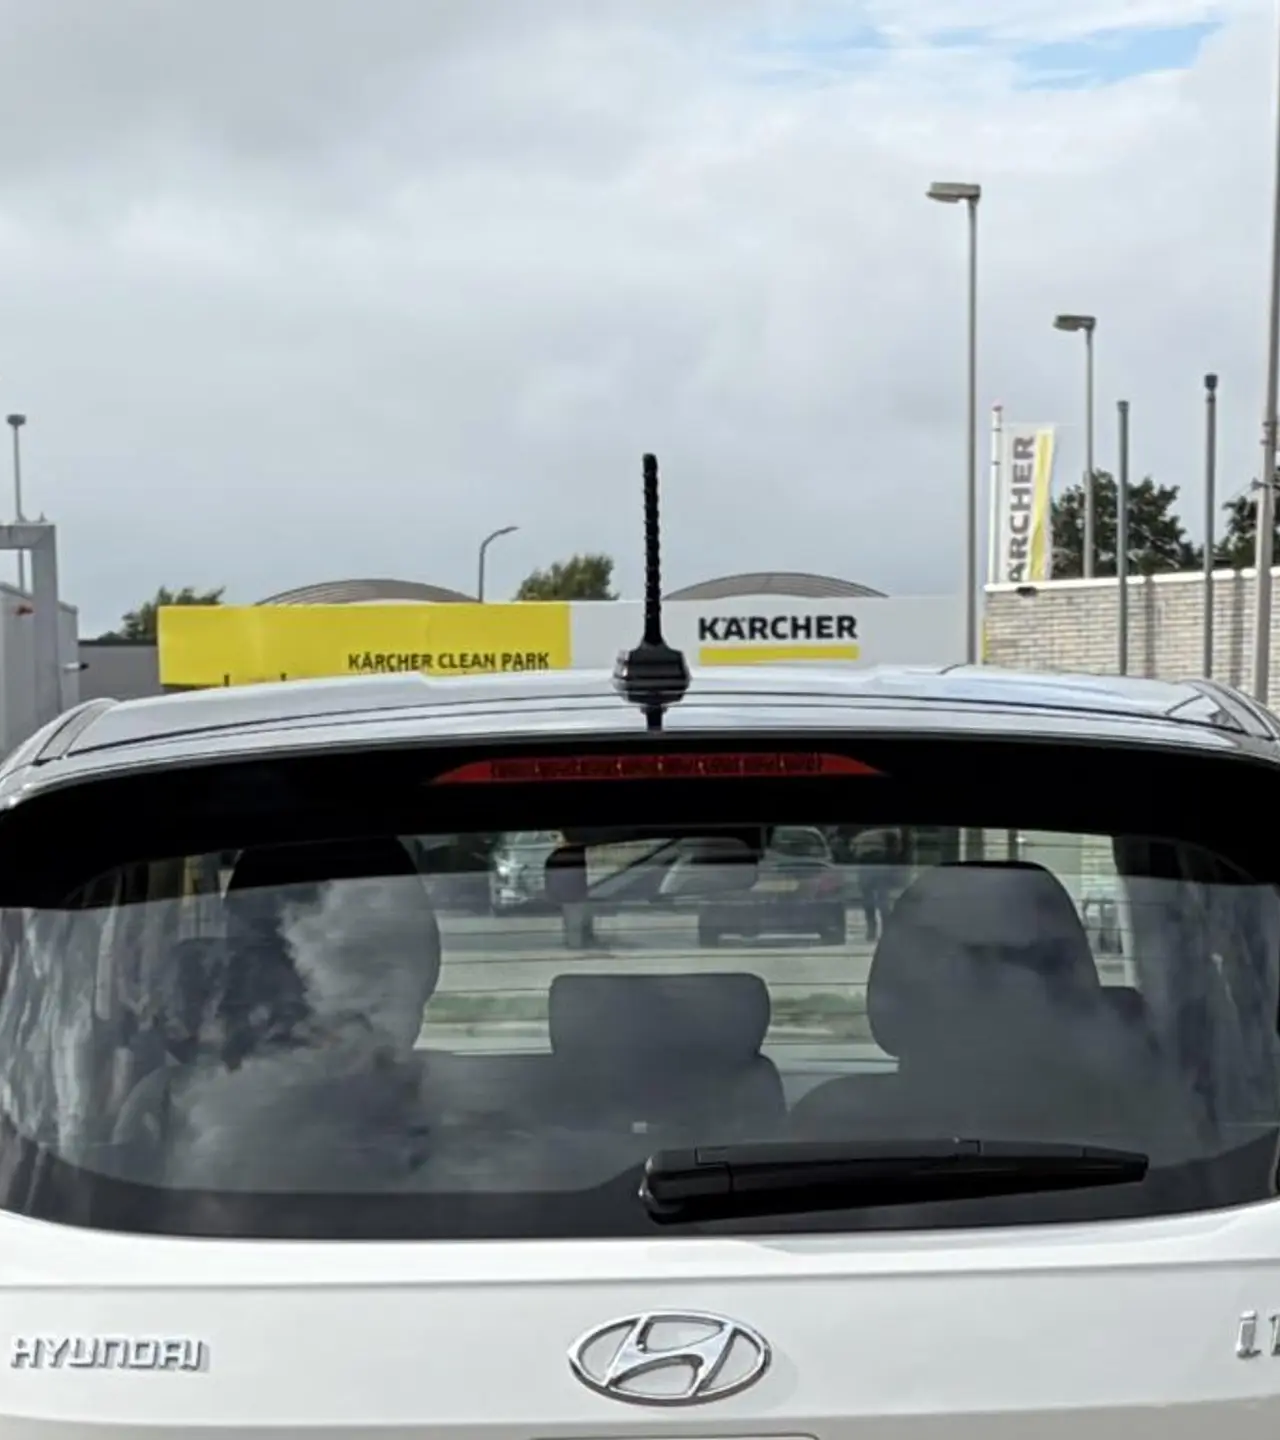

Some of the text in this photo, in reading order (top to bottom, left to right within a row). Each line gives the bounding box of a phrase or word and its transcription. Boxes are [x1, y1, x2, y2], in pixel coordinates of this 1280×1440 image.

[1007, 436, 1035, 583] ÄRCHER
[698, 614, 859, 642] KÄRCHER
[437, 651, 496, 670] CLEAN
[500, 651, 550, 672] PARK
[10, 1337, 206, 1371] HYUNDAI
